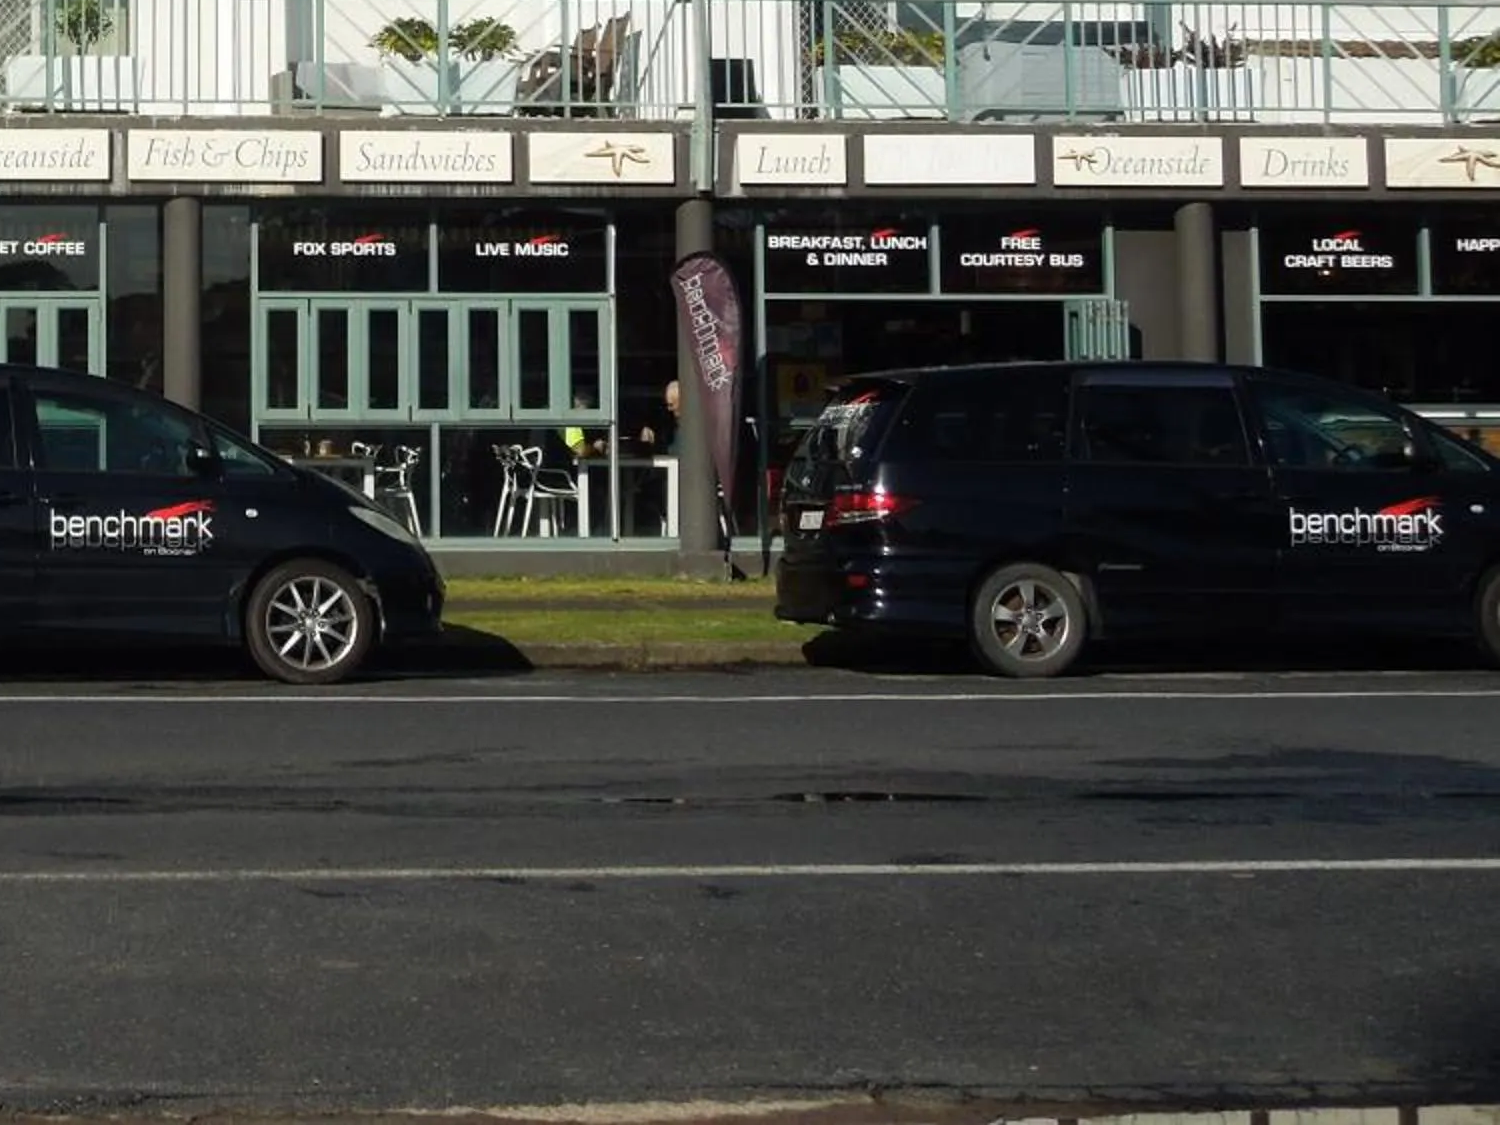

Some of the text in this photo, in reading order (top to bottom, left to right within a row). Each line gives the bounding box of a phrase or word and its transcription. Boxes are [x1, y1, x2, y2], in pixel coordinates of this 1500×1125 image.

[145, 137, 190, 166] Fish
[235, 138, 308, 172] Chips
[357, 141, 496, 172] Sandwiches
[757, 145, 831, 174] Lunch
[1089, 146, 1209, 174] Oceanside
[1264, 149, 1348, 176] Drinks
[23, 240, 85, 255] COFFEE
[294, 242, 396, 255] FOX SPORTS
[476, 242, 568, 256] LIVE MUSIC
[768, 236, 926, 250] BREAKFAST, LUNCH
[1001, 236, 1040, 250] FREE
[1313, 239, 1363, 251] LOCAL
[806, 253, 887, 265] & DINNER
[961, 254, 1083, 267] COURTESY BUS
[1285, 255, 1393, 267] CRAFT BEERS
[682, 273, 731, 388] benchmark
[51, 508, 213, 539] benchmark
[1289, 507, 1444, 535] benchmark
